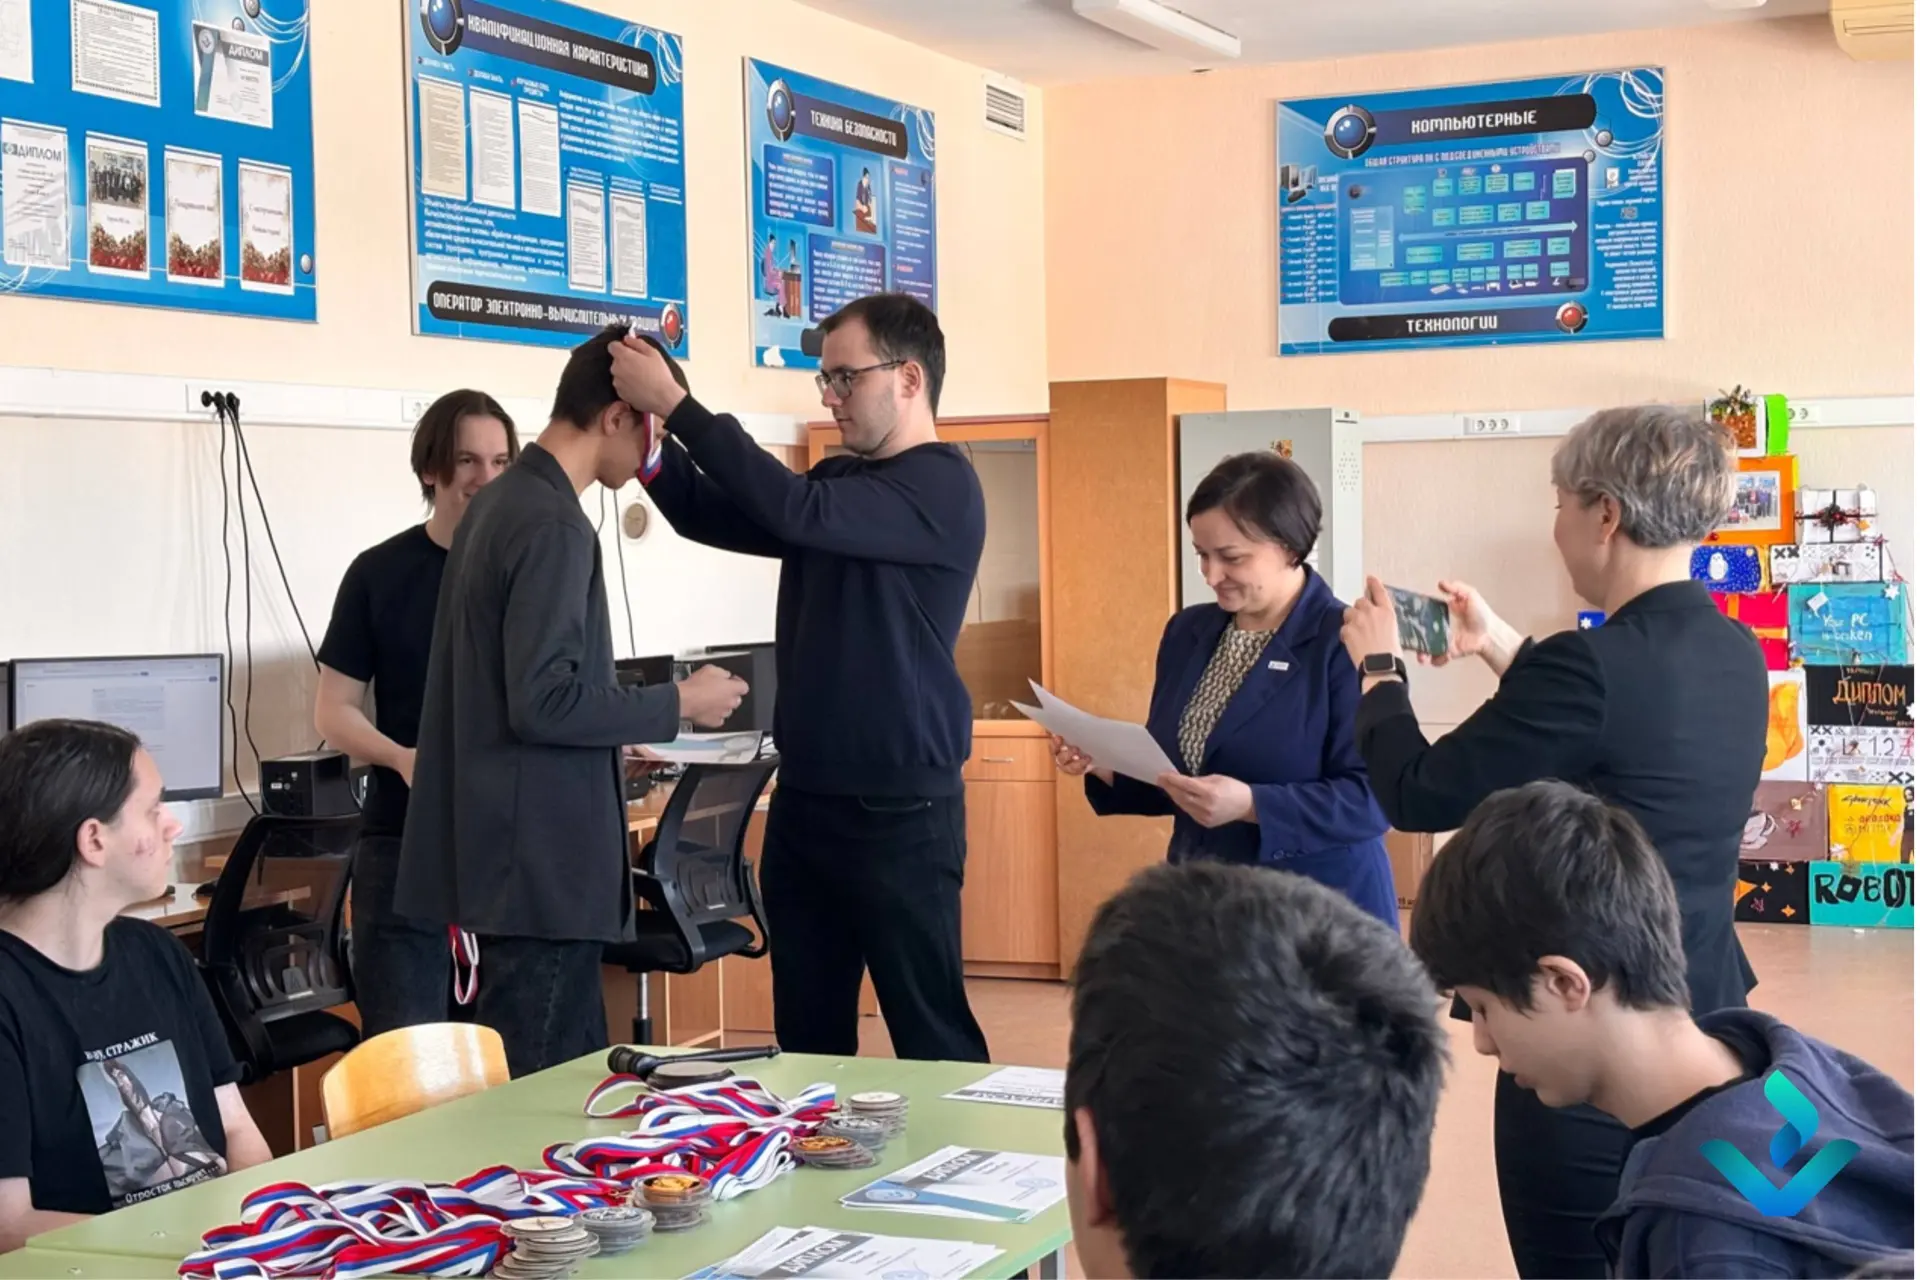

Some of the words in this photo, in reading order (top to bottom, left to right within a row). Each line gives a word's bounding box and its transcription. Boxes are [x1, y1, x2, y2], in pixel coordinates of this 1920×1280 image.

[467, 14, 570, 58] КВАЛИФИКАЦИОННАЯ
[572, 43, 649, 79] ХАРАКТЕРИСТИКА
[810, 110, 843, 132] ТЕХНИКА
[845, 118, 898, 147] БЕЗОПАСНОСТИ
[1411, 109, 1537, 134] КОМПЬЮТЕРНЫЕ
[17, 144, 62, 162] ДИПЛОМ
[433, 292, 483, 313] ОПЕРАТОР
[1406, 315, 1498, 333] ТЕХНОЛОГИИ
[1851, 612, 1868, 628] PC
